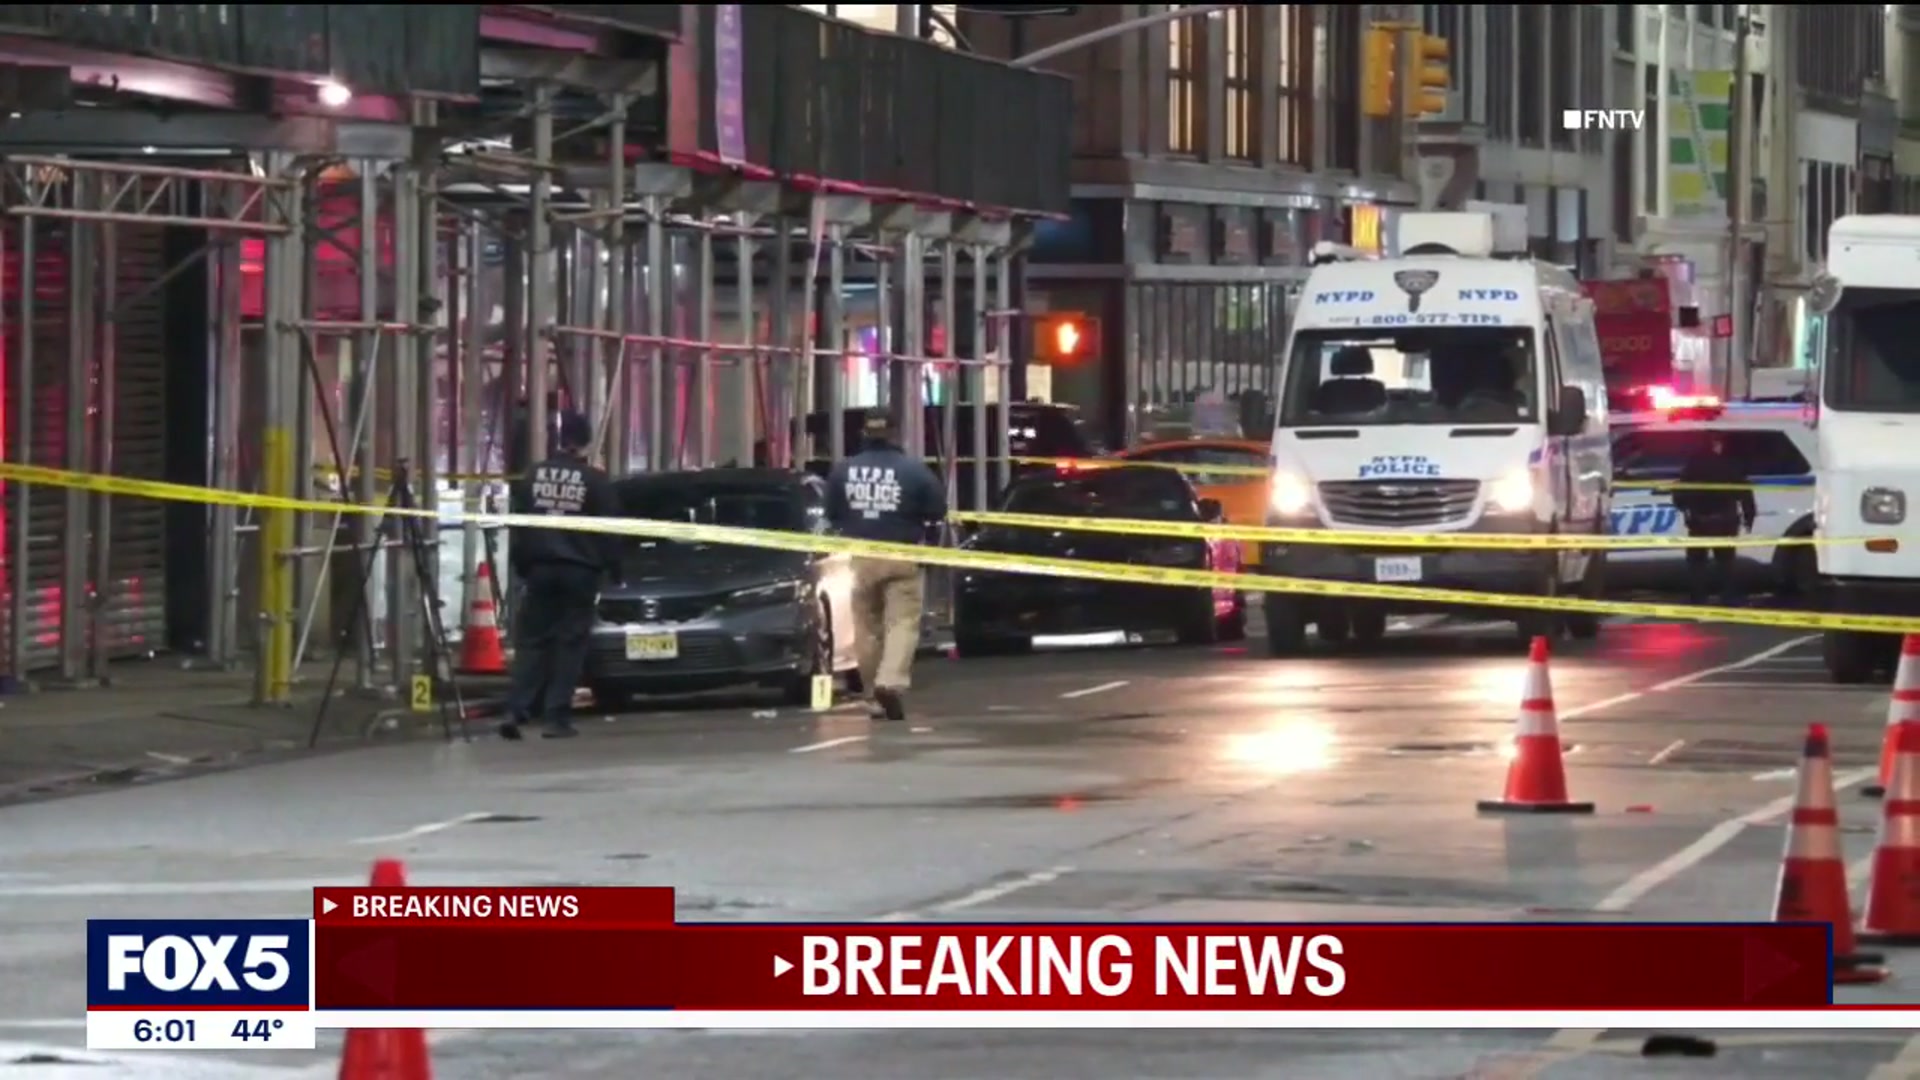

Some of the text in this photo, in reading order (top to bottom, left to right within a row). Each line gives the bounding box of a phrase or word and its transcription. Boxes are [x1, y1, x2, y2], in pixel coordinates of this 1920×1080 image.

[1315, 291, 1374, 304] NYPD
[1458, 289, 1519, 301] NYPD
[1354, 312, 1503, 326] 1-800-577-TIPS
[1358, 463, 1441, 477] POLICE
[533, 482, 587, 503] POLICE
[845, 483, 902, 504] POLICE
[1610, 505, 1677, 534] YPD
[415, 681, 428, 704] 2
